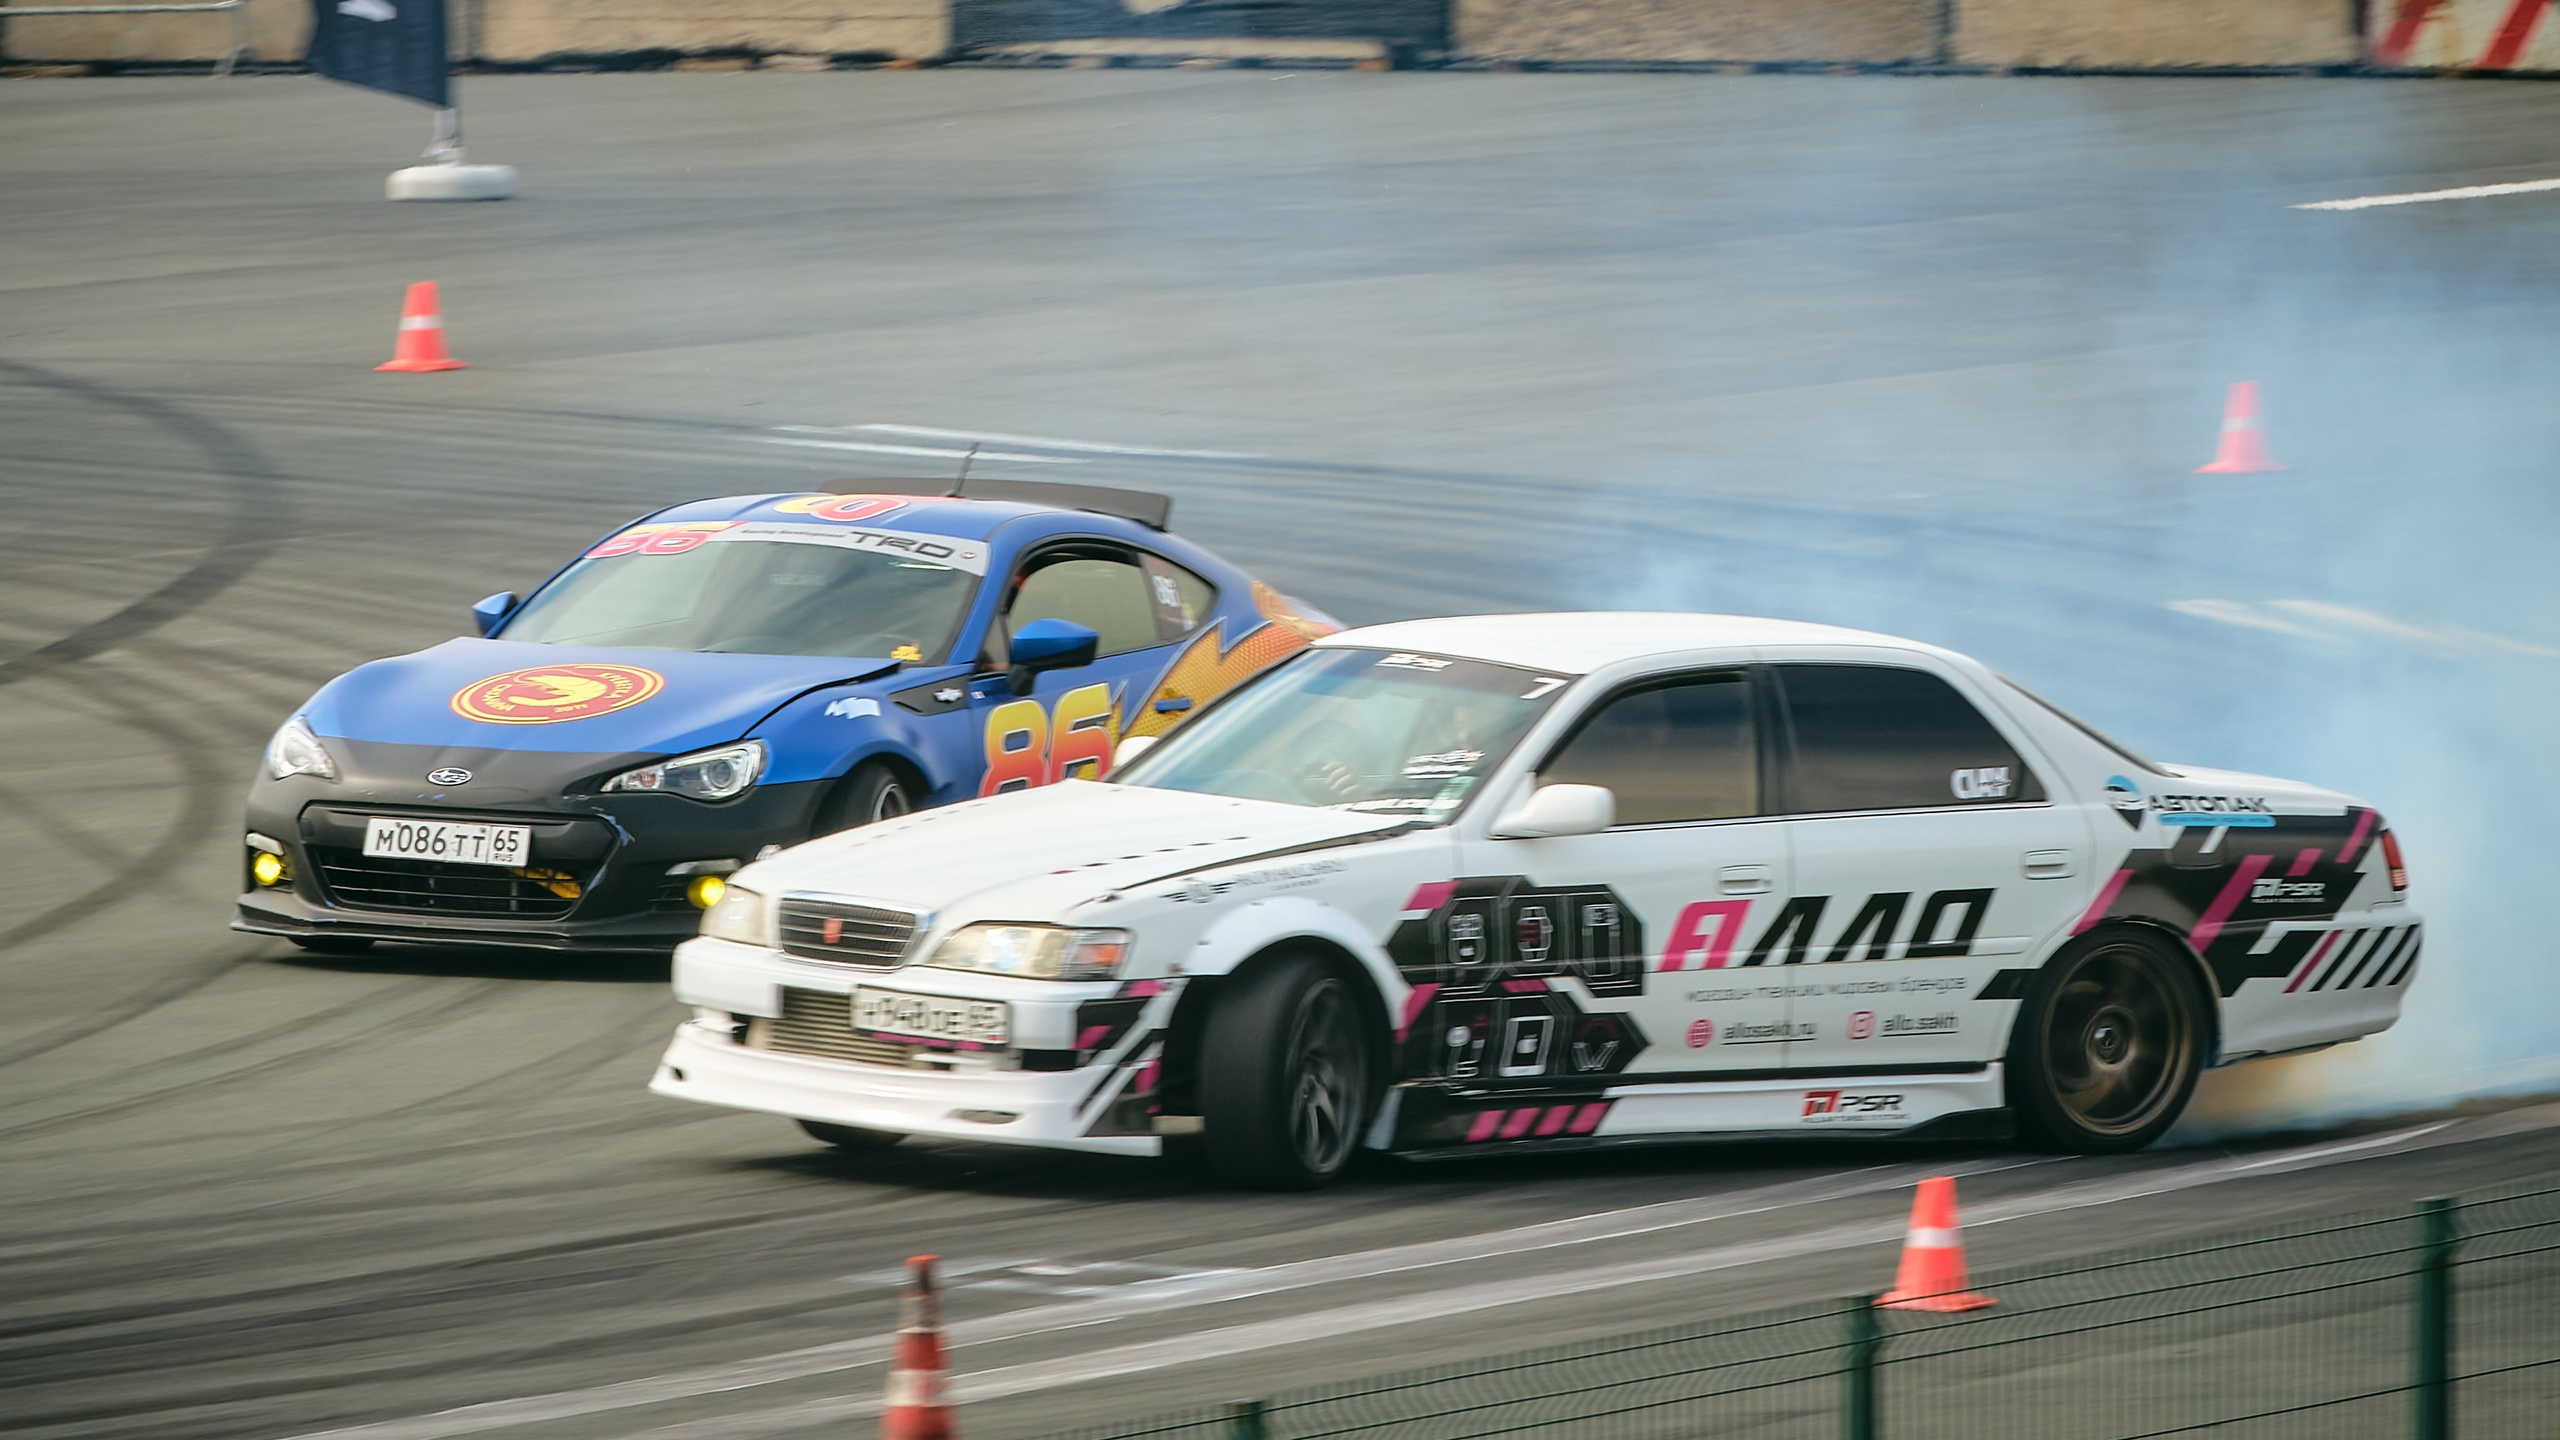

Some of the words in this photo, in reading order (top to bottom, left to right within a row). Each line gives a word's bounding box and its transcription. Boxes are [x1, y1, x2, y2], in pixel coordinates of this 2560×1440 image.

[850, 531, 956, 559] TRD
[1520, 677, 1569, 700] 7
[978, 681, 1114, 799] 86
[2148, 795, 2273, 813] АВТОПАК
[493, 829, 520, 852] 65
[493, 853, 514, 863] RUS
[1656, 888, 1998, 972] АЛЛО
[1837, 1094, 1904, 1112] PSR
